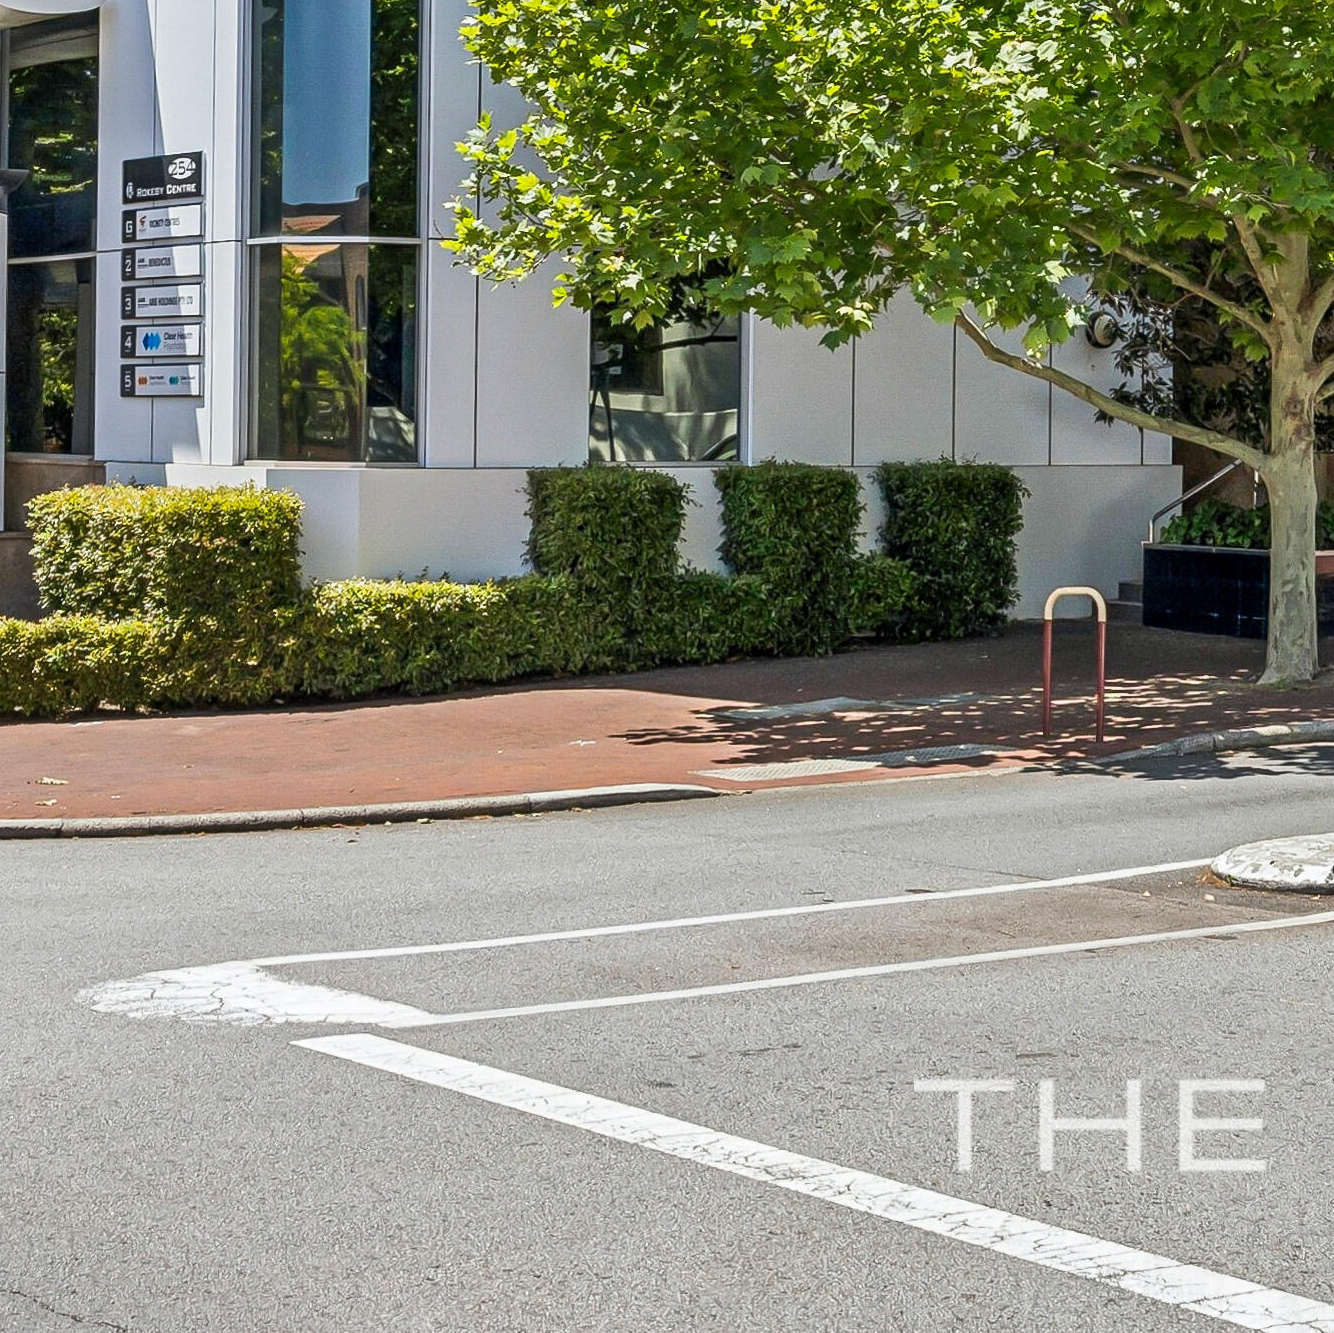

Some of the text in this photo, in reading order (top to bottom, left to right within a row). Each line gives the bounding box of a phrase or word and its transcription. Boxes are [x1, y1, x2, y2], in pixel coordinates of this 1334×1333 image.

[171, 159, 195, 176] 254
[136, 187, 165, 197] ROKEBY
[167, 183, 197, 194] CENTRE
[125, 220, 133, 234] G
[125, 259, 132, 272] 2
[125, 297, 132, 310] 3
[124, 335, 132, 349] 4
[124, 374, 132, 388] 5
